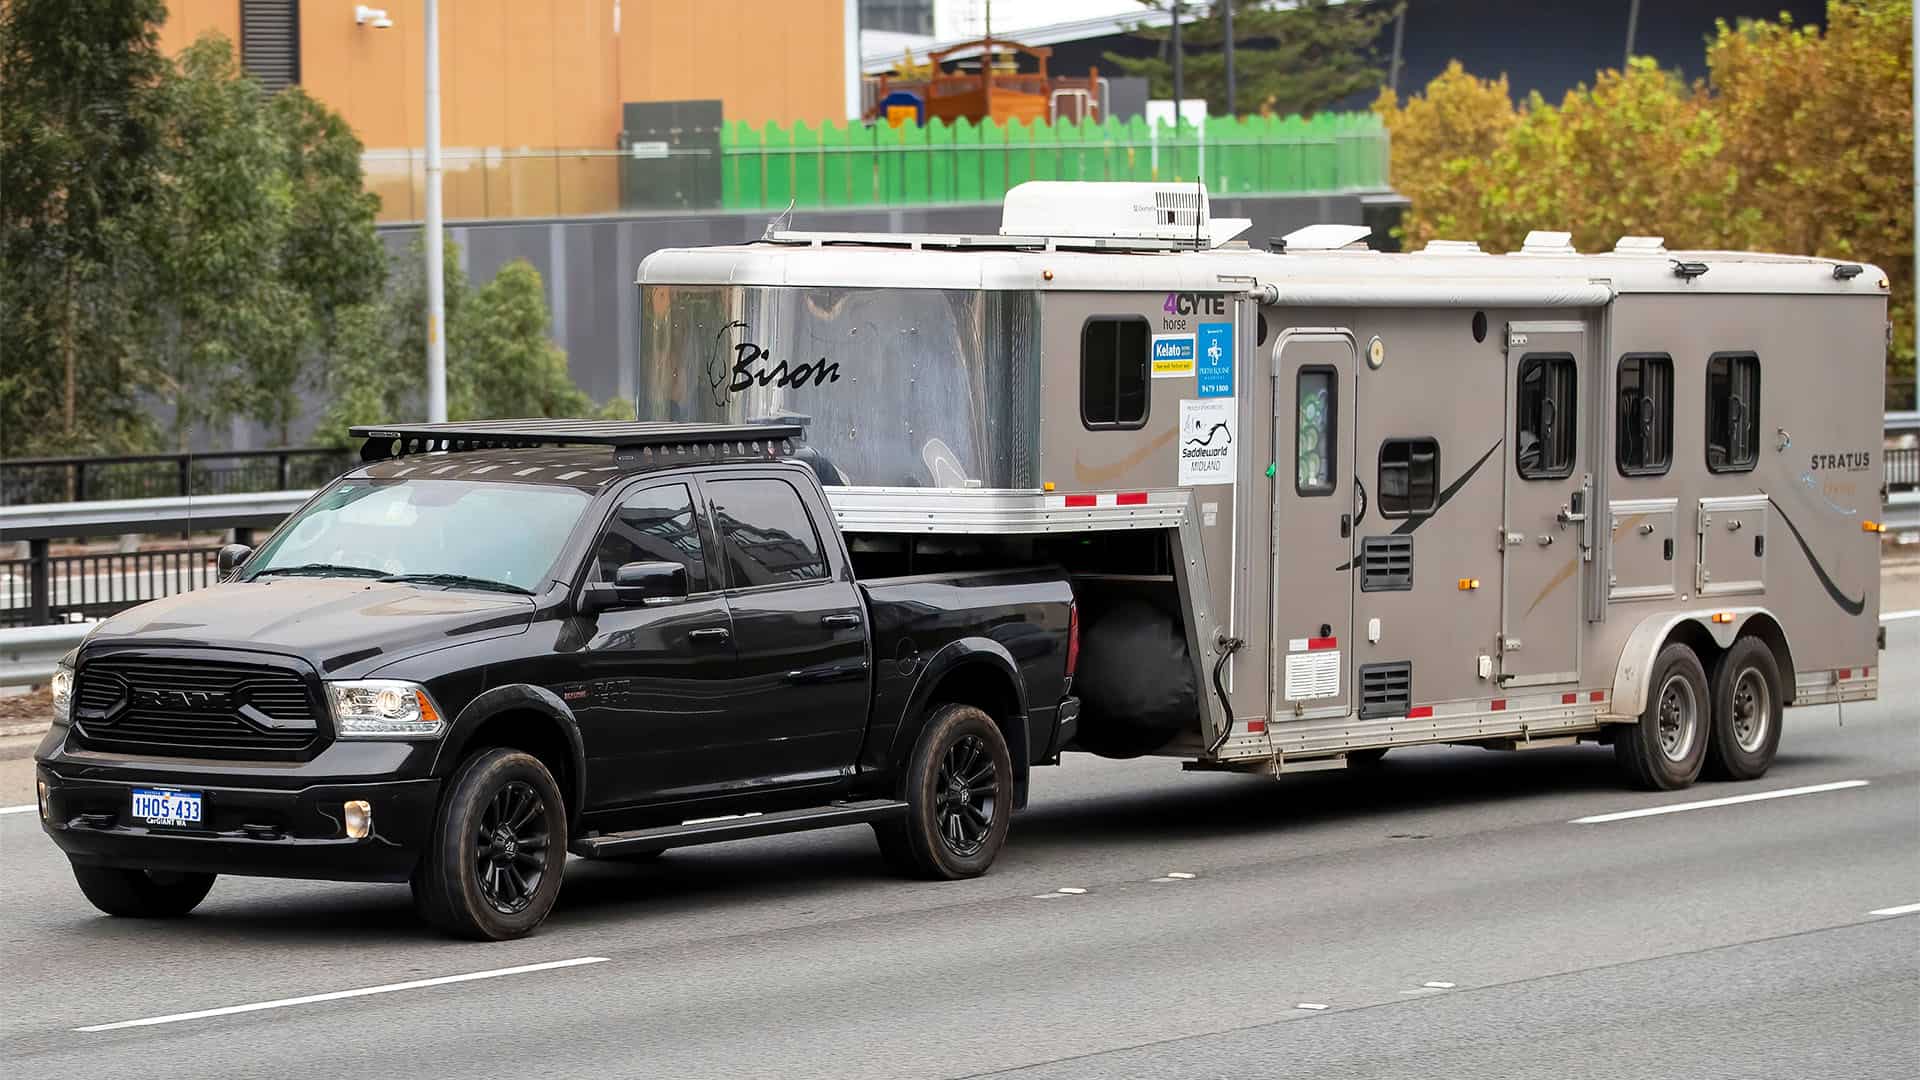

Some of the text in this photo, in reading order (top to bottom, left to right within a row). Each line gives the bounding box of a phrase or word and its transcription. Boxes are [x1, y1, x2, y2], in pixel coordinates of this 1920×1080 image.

[1163, 292, 1225, 316] 4CYTE
[1163, 316, 1186, 331] horse
[1156, 343, 1182, 357] Kelato
[729, 342, 841, 393] Bison
[1182, 445, 1228, 459] Saddleworld
[1191, 460, 1221, 472] MIDLAND
[1811, 452, 1870, 471] STRATUS
[135, 797, 200, 820] 1HOS-433
